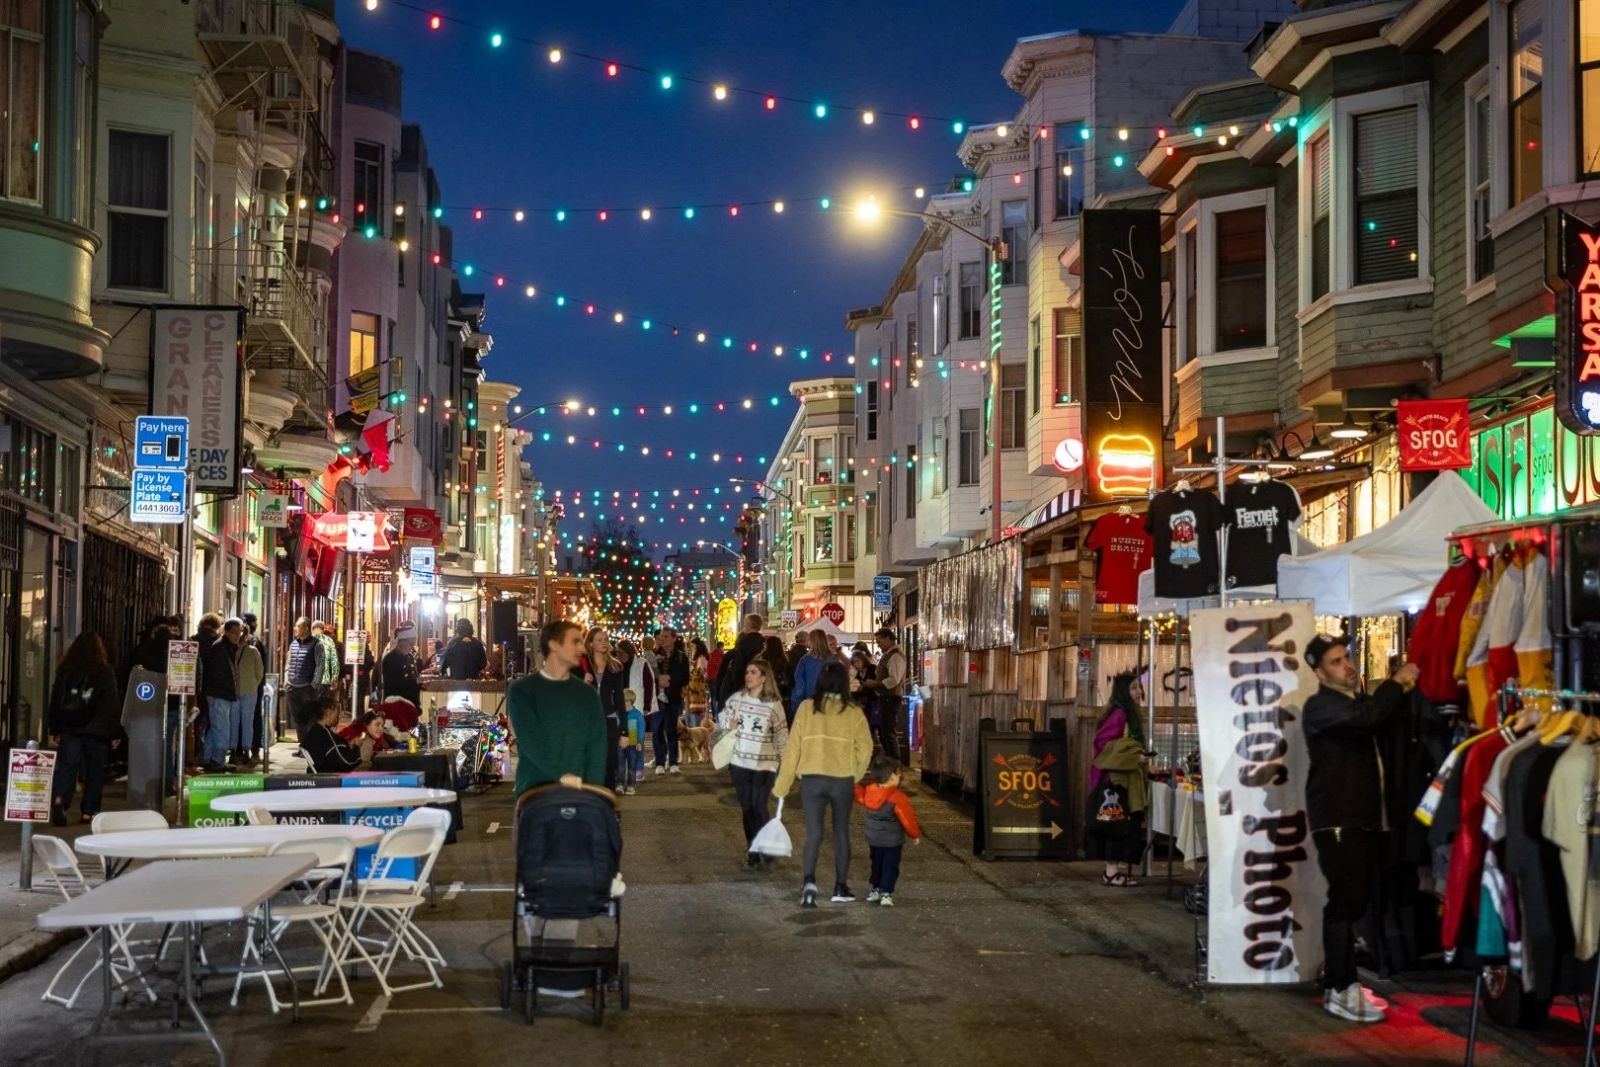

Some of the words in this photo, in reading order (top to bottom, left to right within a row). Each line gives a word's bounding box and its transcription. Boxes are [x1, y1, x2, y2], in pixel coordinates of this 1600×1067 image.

[1578, 233, 1600, 382] YARSA
[1100, 224, 1144, 421] mo's
[166, 316, 192, 417] GRAN
[200, 313, 225, 448] CLEANERS
[140, 422, 159, 433] Pay
[161, 422, 185, 433] here
[1410, 429, 1458, 450] SFOG
[200, 448, 229, 463] DAY
[1533, 452, 1553, 478] SFOG
[137, 473, 155, 484] Pay
[157, 473, 170, 484] by
[198, 465, 227, 481] CES
[137, 482, 172, 492] License
[136, 492, 161, 501] Plate
[137, 503, 180, 513] 44413003
[1236, 506, 1279, 524] Fernet
[1110, 537, 1145, 545] NORTH
[1110, 545, 1144, 553] BEACH
[821, 610, 844, 620] STOP
[782, 620, 796, 629] 20
[1225, 612, 1299, 788] Nietos
[998, 771, 1052, 791] SFOG
[349, 815, 403, 826] RECYCLE
[1242, 809, 1308, 972] Photo
